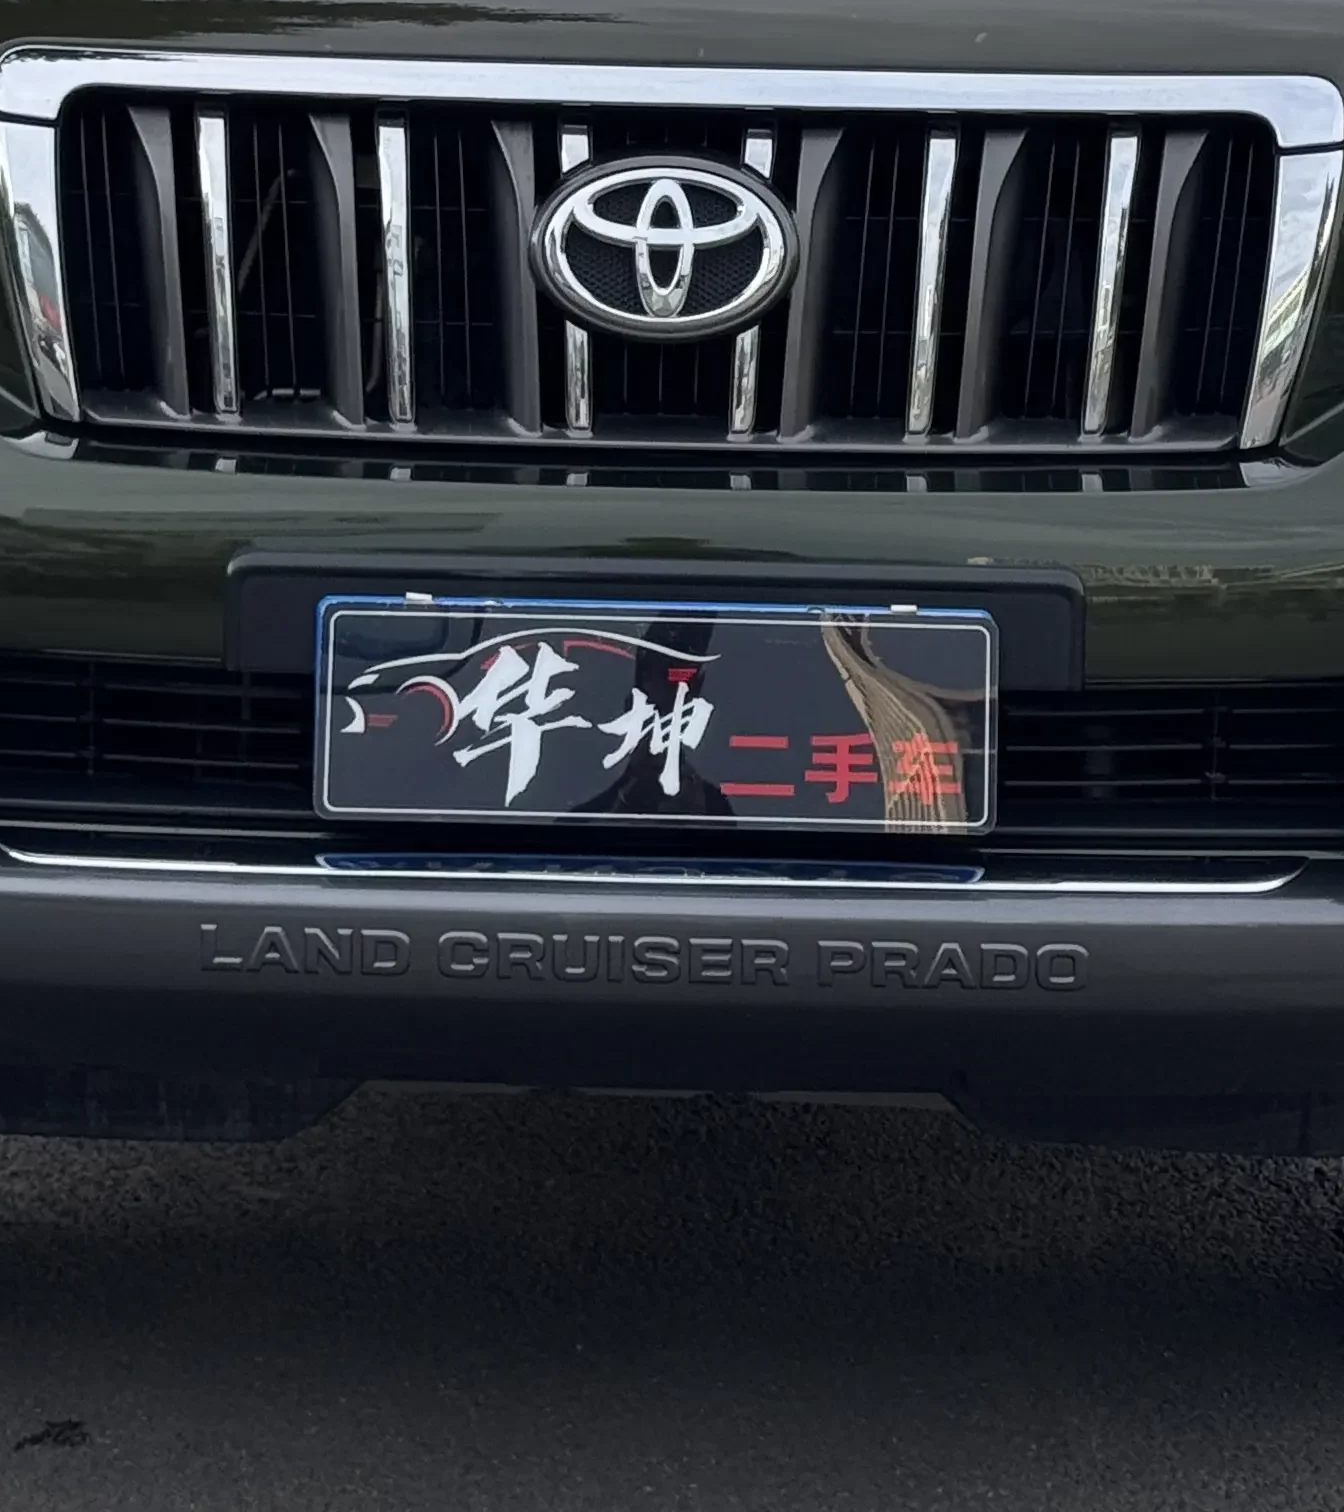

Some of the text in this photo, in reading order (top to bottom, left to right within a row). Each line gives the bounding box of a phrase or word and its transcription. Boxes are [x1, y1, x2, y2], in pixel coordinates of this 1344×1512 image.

[455, 641, 961, 807] 华坤 二手车
[199, 923, 1089, 992] LAND CRUISER PRADO
